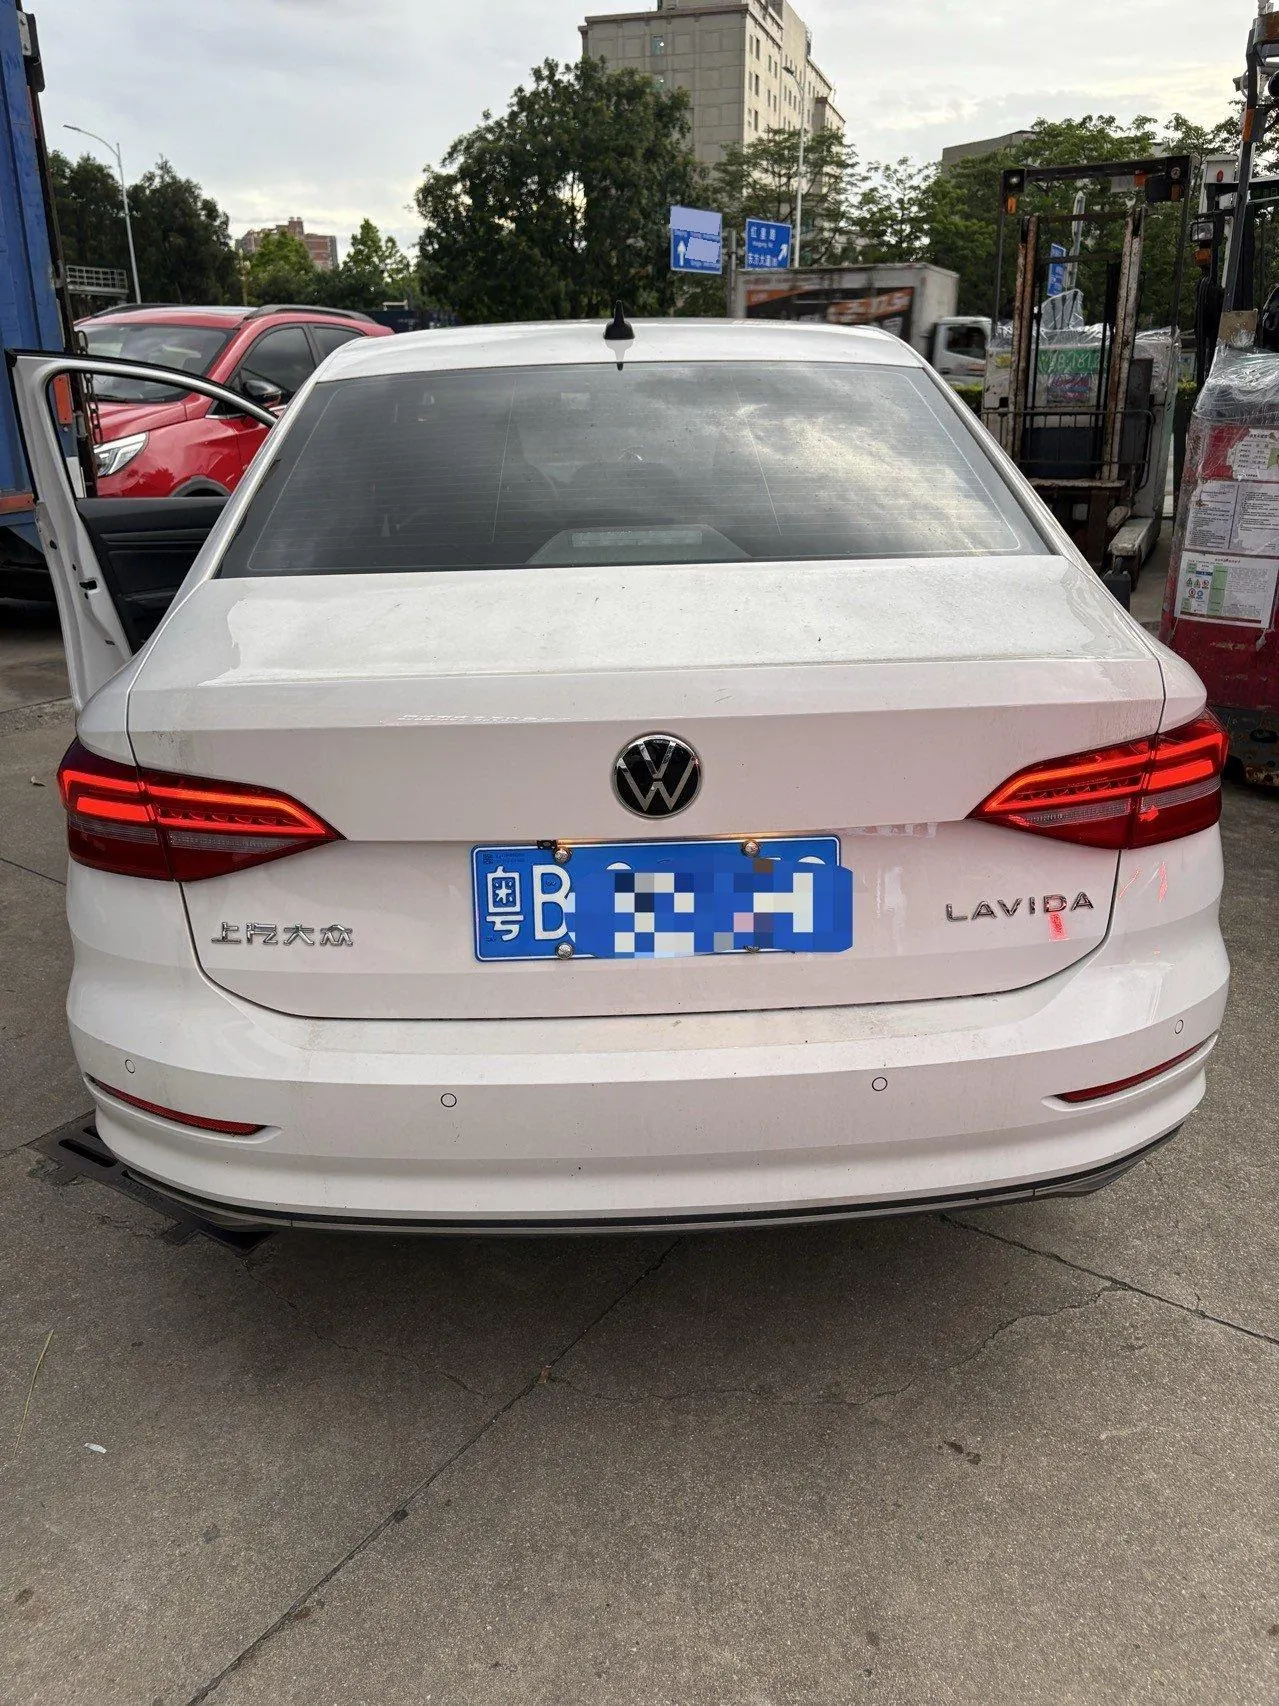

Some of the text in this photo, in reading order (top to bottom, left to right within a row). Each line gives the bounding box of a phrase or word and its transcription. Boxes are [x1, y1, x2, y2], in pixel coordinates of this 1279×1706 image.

[945, 891, 1094, 922] LAVIDA
[211, 922, 353, 946] 上汽大众
